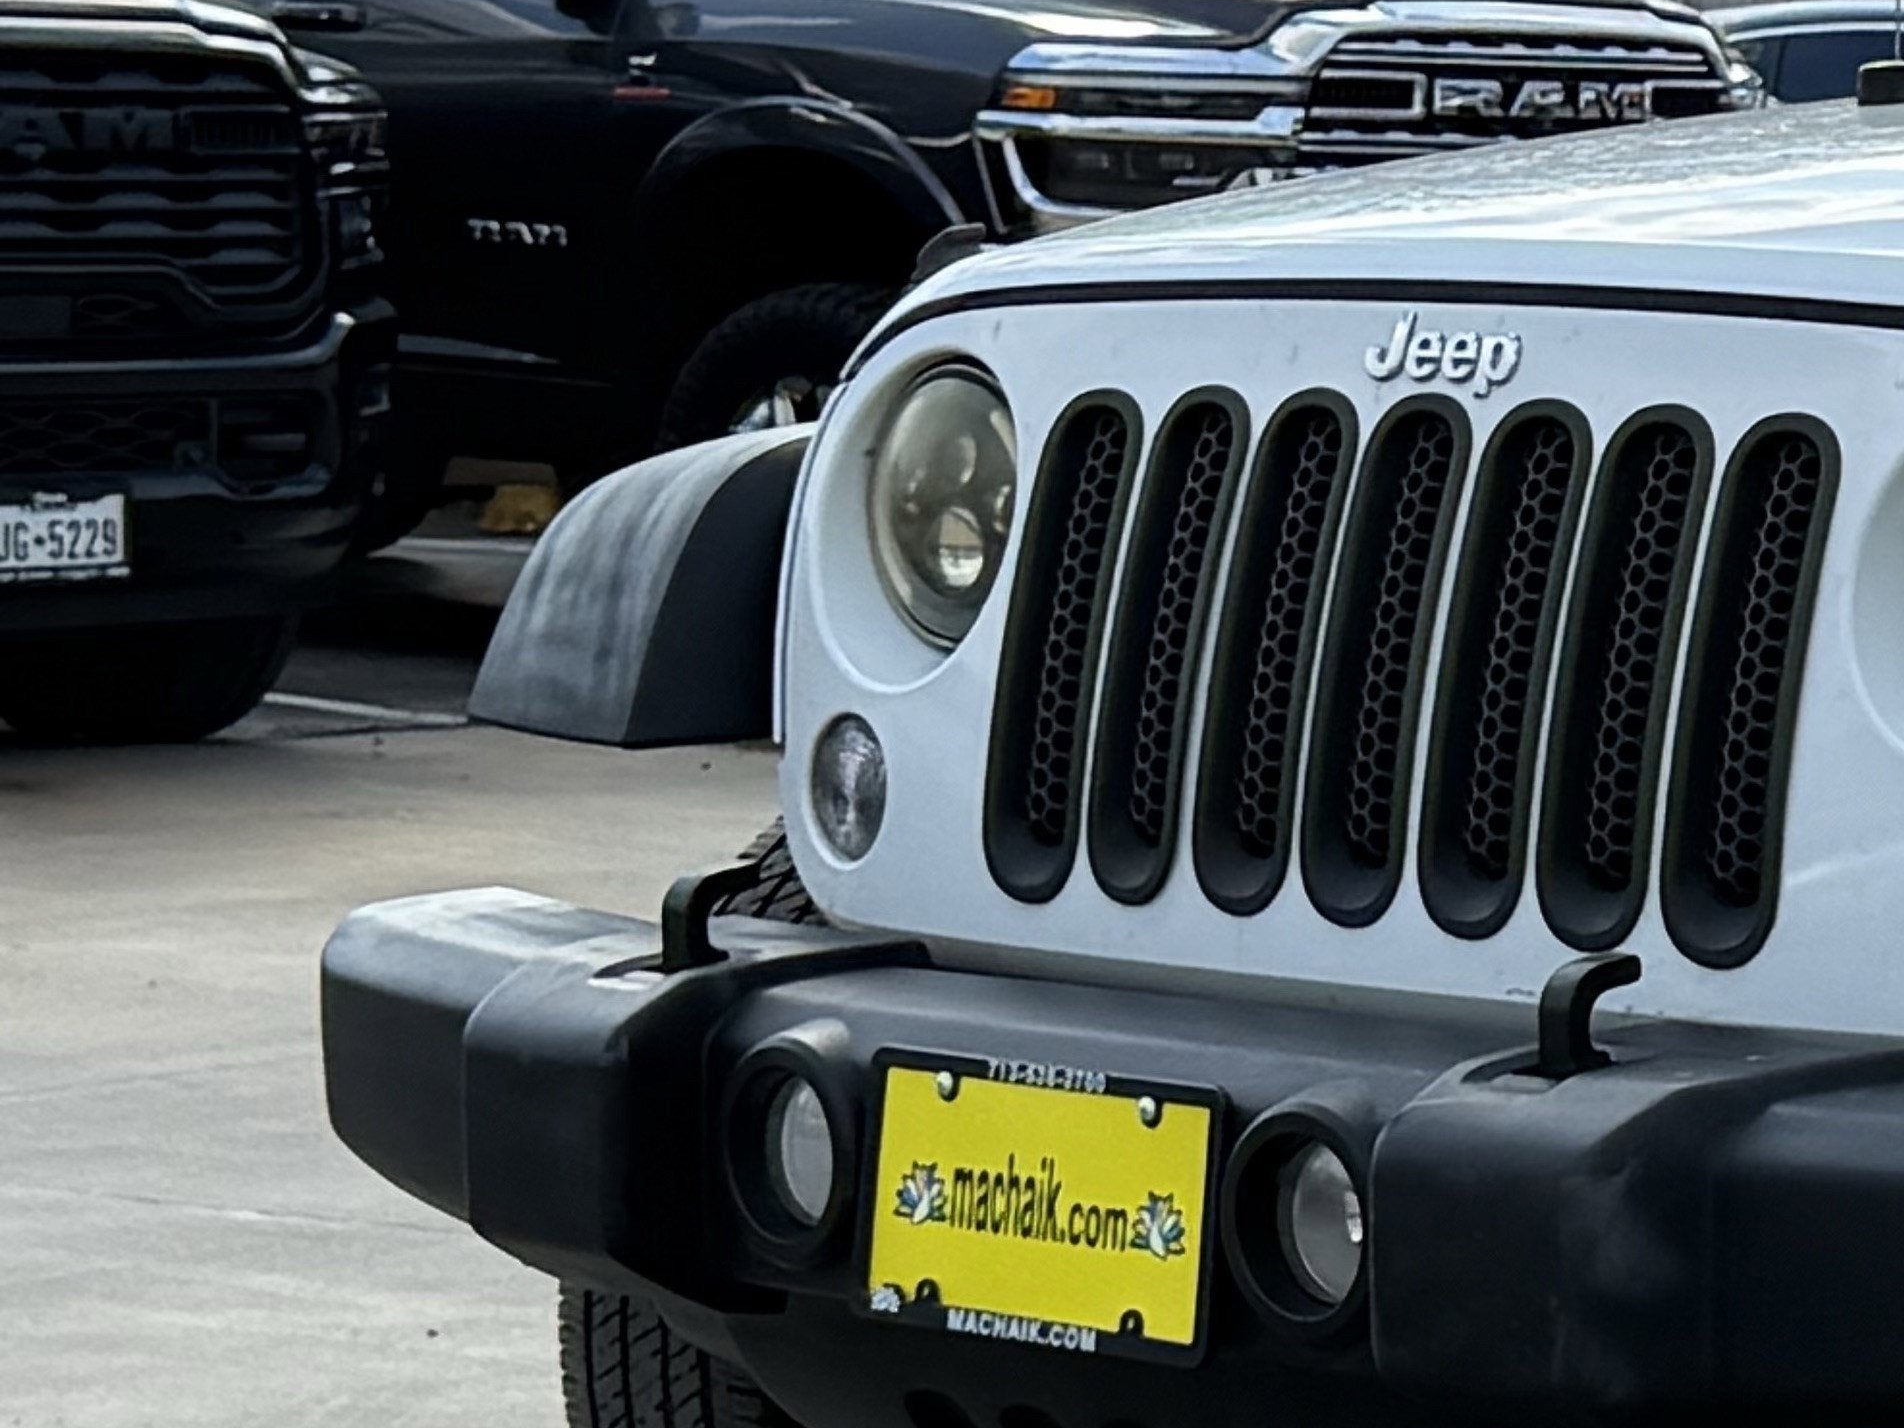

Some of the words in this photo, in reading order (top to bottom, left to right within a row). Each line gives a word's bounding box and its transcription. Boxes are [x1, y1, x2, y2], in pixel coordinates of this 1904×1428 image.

[1432, 78, 1648, 120] RAM
[1364, 311, 1522, 399] Jeep
[948, 1152, 1128, 1252] machaik.com
[947, 1308, 1097, 1352] MACHAIK.COM
